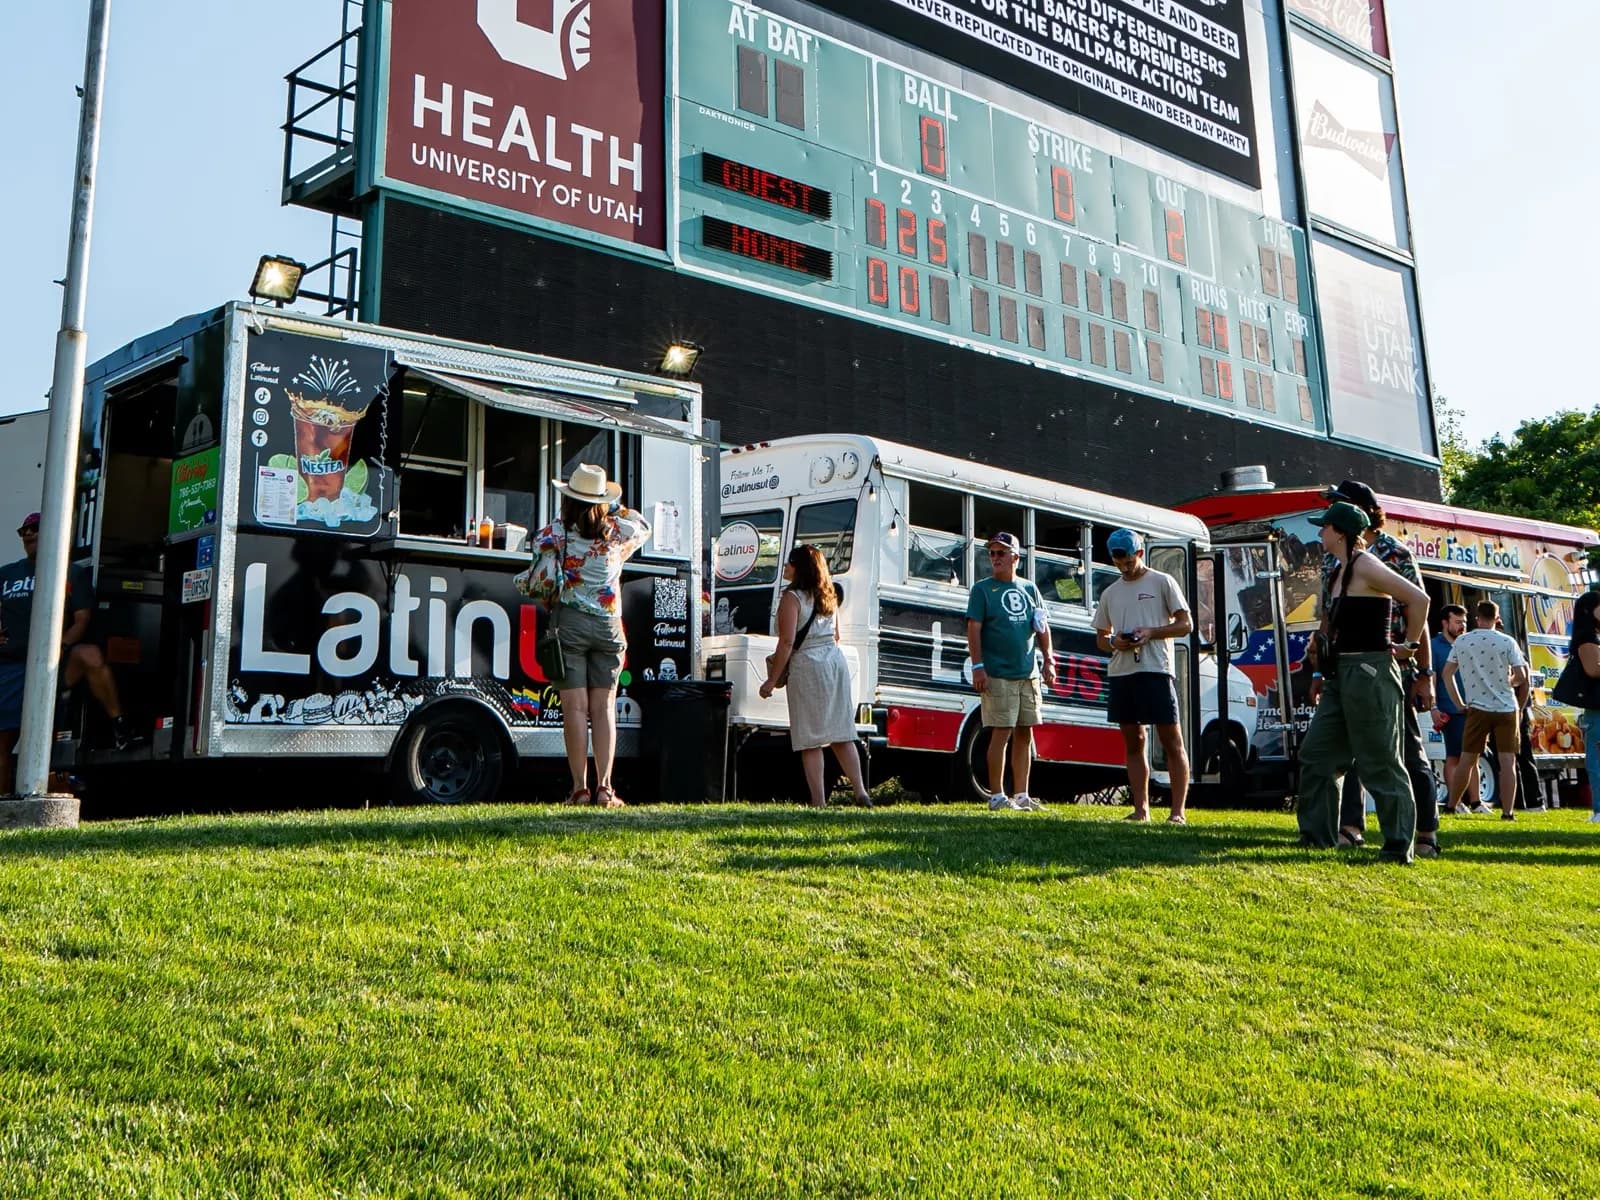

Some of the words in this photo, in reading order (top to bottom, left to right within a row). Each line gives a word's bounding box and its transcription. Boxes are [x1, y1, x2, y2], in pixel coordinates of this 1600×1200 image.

[728, 5, 758, 43] AT
[768, 20, 812, 63] BAT
[1168, 9, 1198, 32] AND
[1202, 25, 1236, 52] BEER
[955, 12, 1033, 57] REPLICATED
[1035, 46, 1060, 69] THE
[1062, 61, 1119, 97] ORIGINAL
[1120, 86, 1138, 104] PIE
[1141, 95, 1163, 115] AND
[1166, 107, 1192, 129] BEER
[1195, 119, 1215, 137] DAY
[1216, 128, 1247, 150] PARTY
[1011, 3, 1048, 37] THE
[1052, 22, 1138, 79] BALLPARK
[1141, 66, 1198, 105] ACTION
[1200, 91, 1240, 124] TEAM
[1113, 30, 1126, 50] &
[1129, 37, 1203, 86] BREWERS
[1181, 42, 1228, 78] BEERS
[699, 106, 756, 131] DAKTRONICS
[905, 74, 958, 121] BALL
[413, 73, 643, 193] HEALTH
[920, 115, 945, 174] 0
[1027, 123, 1093, 174] STRIKE
[411, 142, 547, 198] UNIVERSITY
[552, 184, 582, 208] OF
[588, 193, 643, 226] UTAH
[722, 160, 812, 213] GUEST
[1052, 165, 1074, 220] 0
[1155, 176, 1188, 207] OUT
[731, 223, 808, 273] HOME
[869, 169, 878, 193] 1
[901, 179, 912, 204] 2
[931, 190, 942, 215] 3
[970, 204, 981, 227] 4
[999, 214, 1009, 237] 5
[1026, 223, 1036, 245] 6
[1063, 235, 1071, 257] 7
[1088, 244, 1096, 265] 8
[1112, 252, 1121, 274] 9
[1141, 263, 1157, 286] 10
[899, 209, 917, 256] 2
[928, 218, 947, 265] 5
[1166, 209, 1185, 262] 2
[868, 257, 888, 304] 0
[900, 267, 919, 313] 0
[1191, 280, 1228, 310] RUNS
[1238, 295, 1266, 323] HITS
[1284, 311, 1308, 337] ERR
[1363, 319, 1417, 364] UTAH
[1367, 356, 1424, 397] BANK
[301, 459, 345, 474] NESTEA
[717, 544, 755, 557] Latinus
[1446, 536, 1479, 564] Fast
[1483, 542, 1520, 569] Food
[2, 576, 36, 596] Lati
[1008, 592, 1023, 611] B
[240, 562, 563, 685] Latinu
